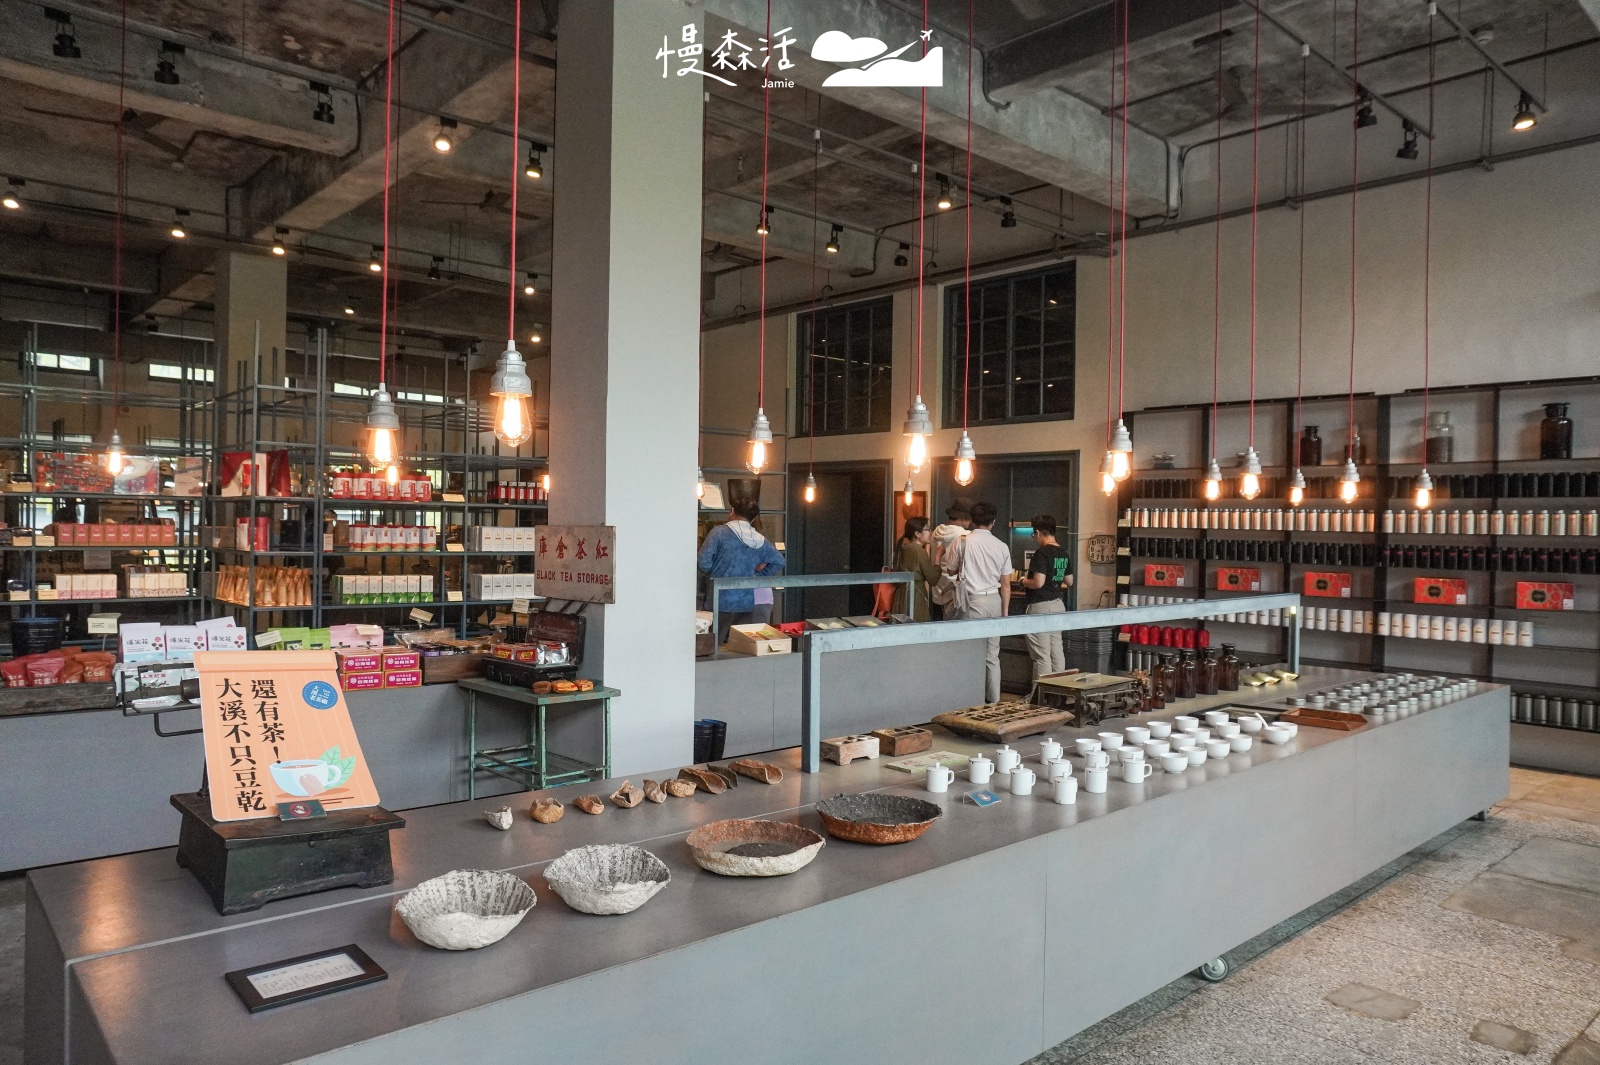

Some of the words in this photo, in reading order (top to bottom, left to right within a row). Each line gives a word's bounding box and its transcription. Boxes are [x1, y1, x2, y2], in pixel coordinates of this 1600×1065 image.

[536, 570, 556, 580] BLACK
[560, 572, 573, 582] TEA
[577, 573, 609, 585] STORAGE
[215, 677, 267, 813] 大溪不只豆乾
[250, 679, 285, 764] 還有茶！
